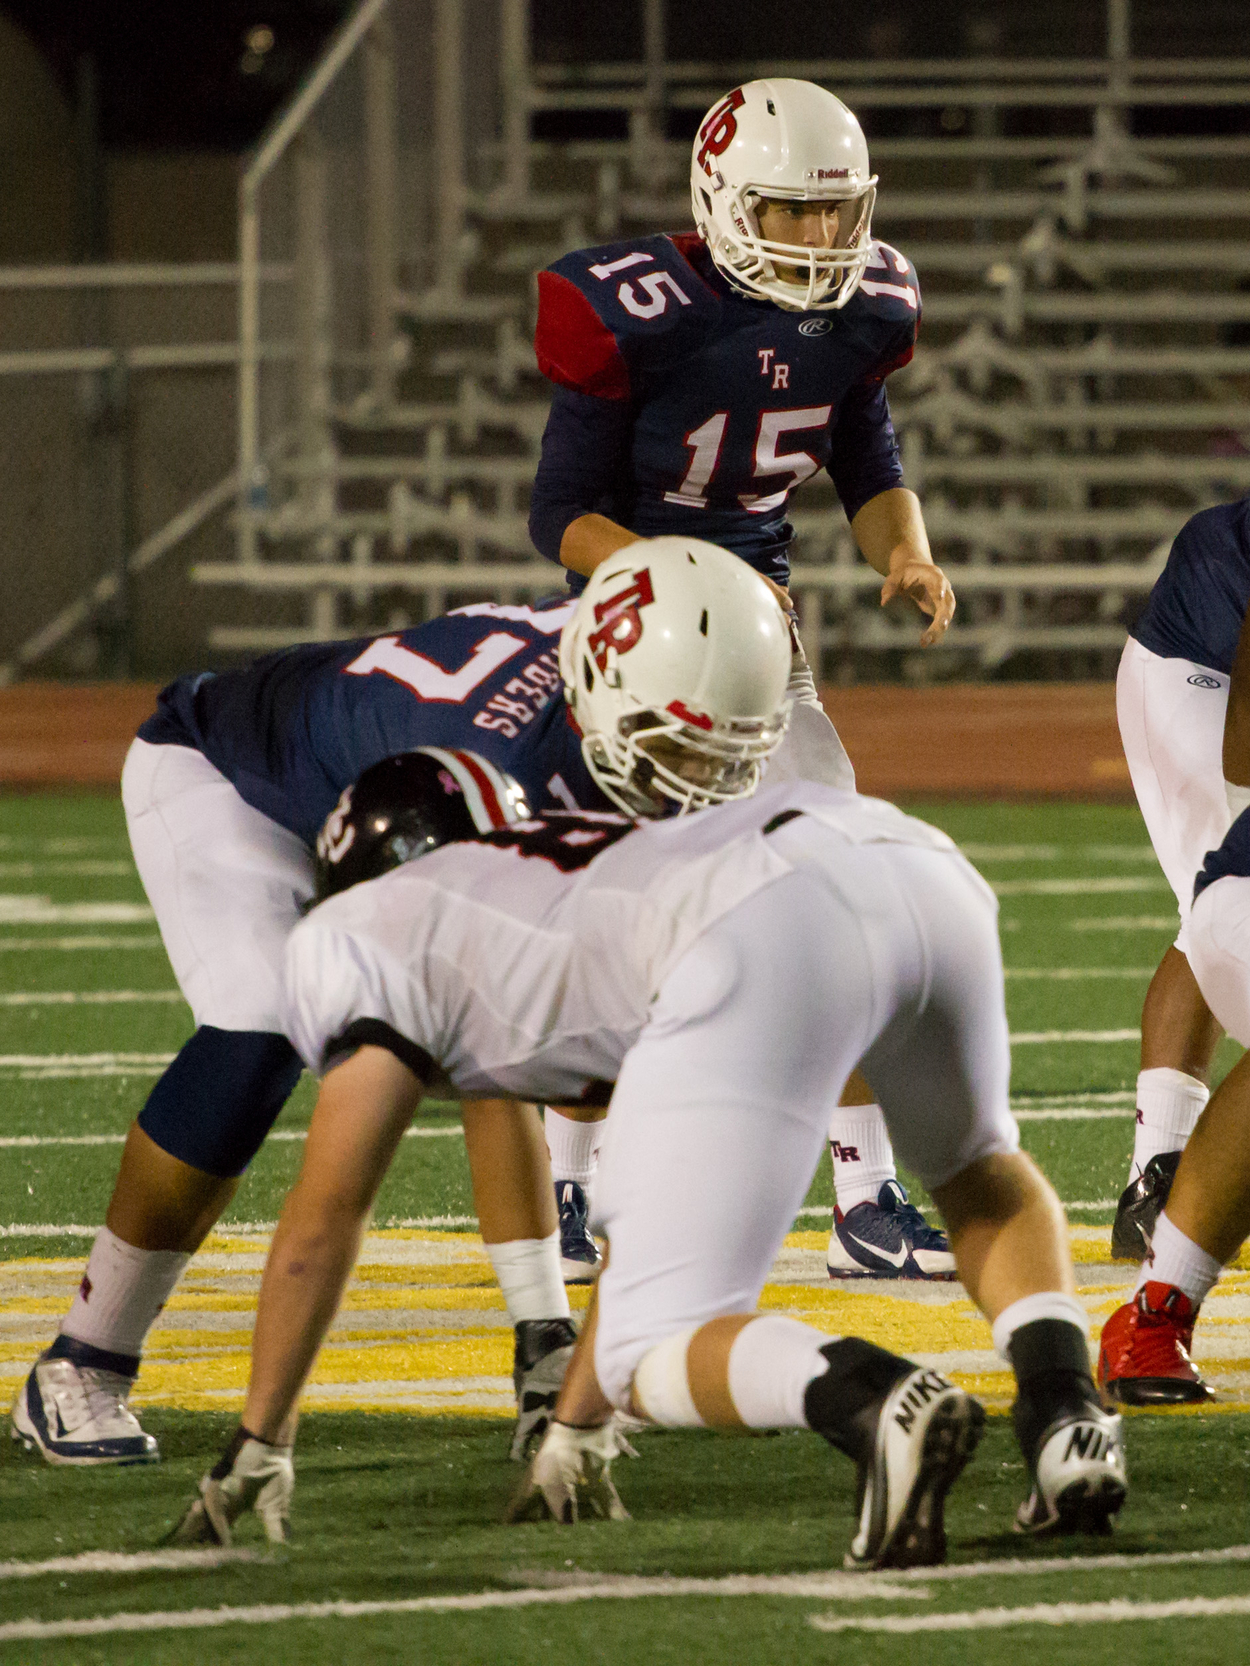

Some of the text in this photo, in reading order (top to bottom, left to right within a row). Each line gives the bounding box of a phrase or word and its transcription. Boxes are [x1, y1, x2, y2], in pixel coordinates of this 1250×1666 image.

[817, 168, 849, 179] Riddell
[588, 251, 692, 321] 15
[662, 403, 834, 516] 15
